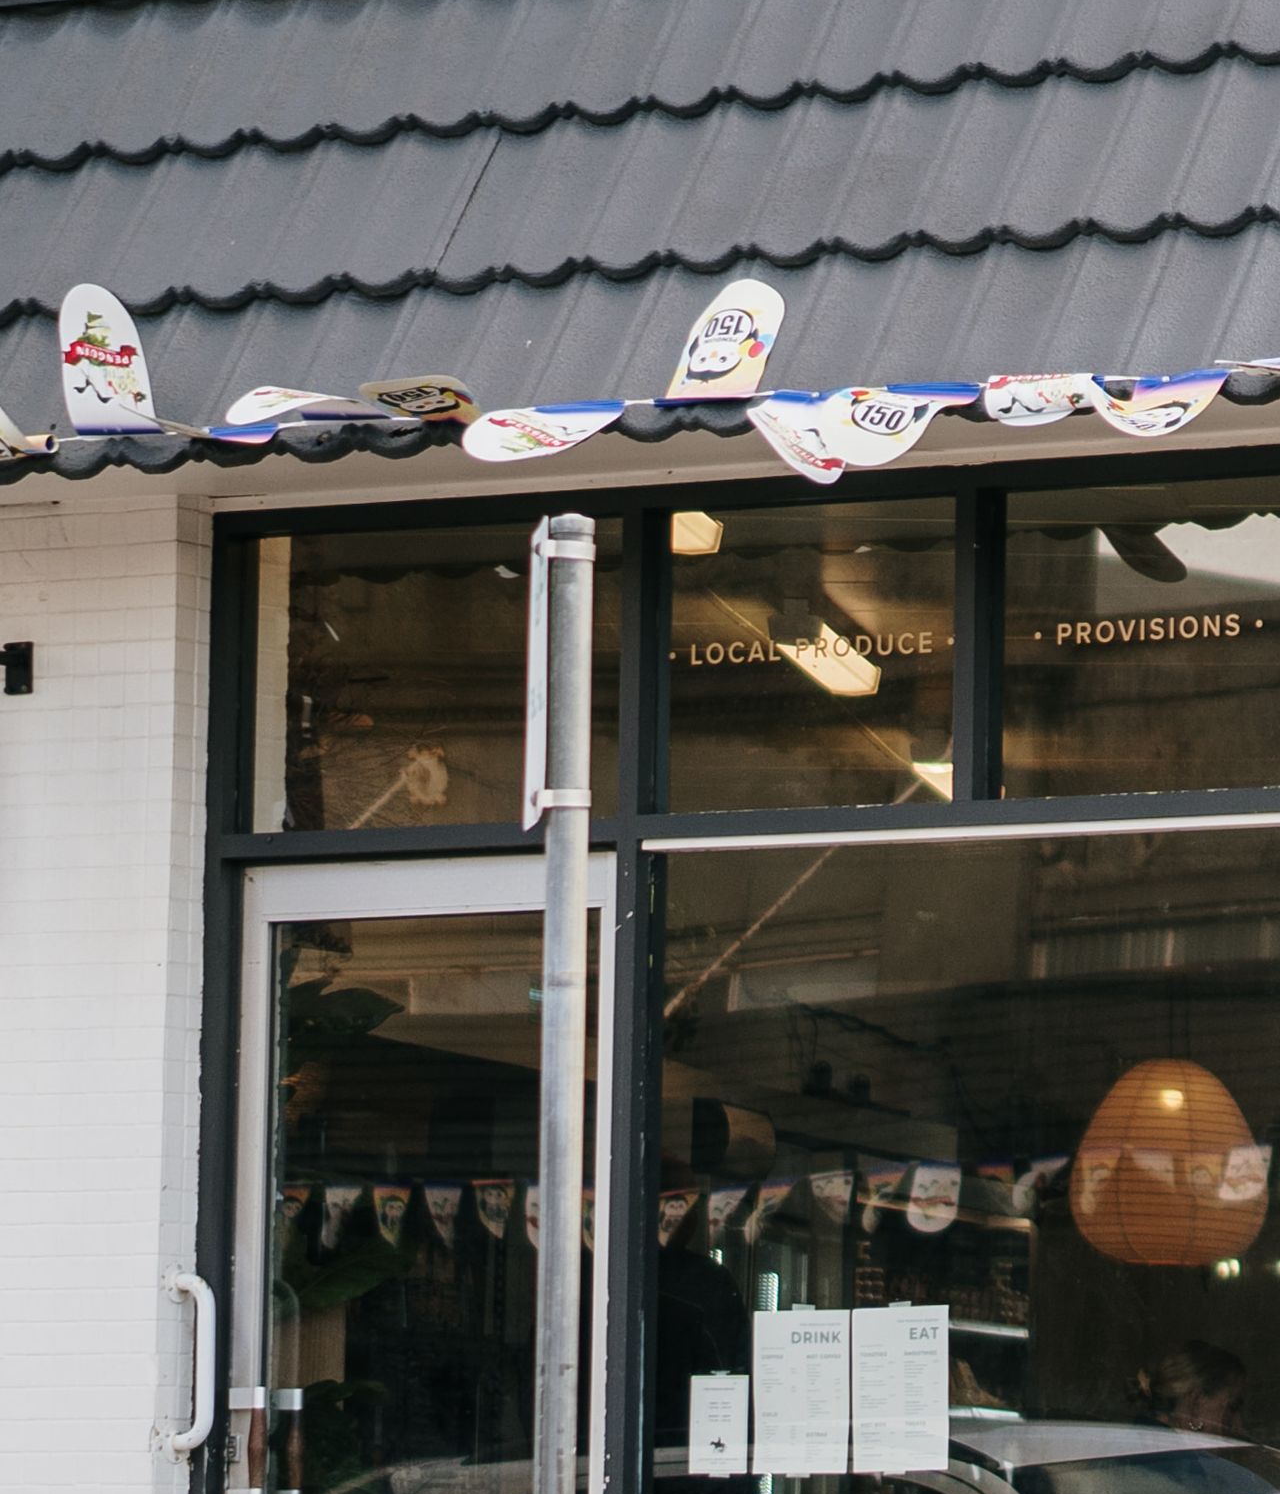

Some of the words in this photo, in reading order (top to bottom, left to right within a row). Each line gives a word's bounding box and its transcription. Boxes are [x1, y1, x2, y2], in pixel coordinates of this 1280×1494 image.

[704, 315, 745, 339] 150
[76, 345, 130, 365] PENGUIN
[391, 386, 437, 402] 150
[860, 405, 906, 431] 150
[1057, 613, 1241, 645] PROVISIONS
[690, 640, 782, 665] LOCAL
[795, 631, 934, 659] PRODUCE
[791, 1331, 841, 1344] DRINK
[909, 1326, 940, 1340] EAT
